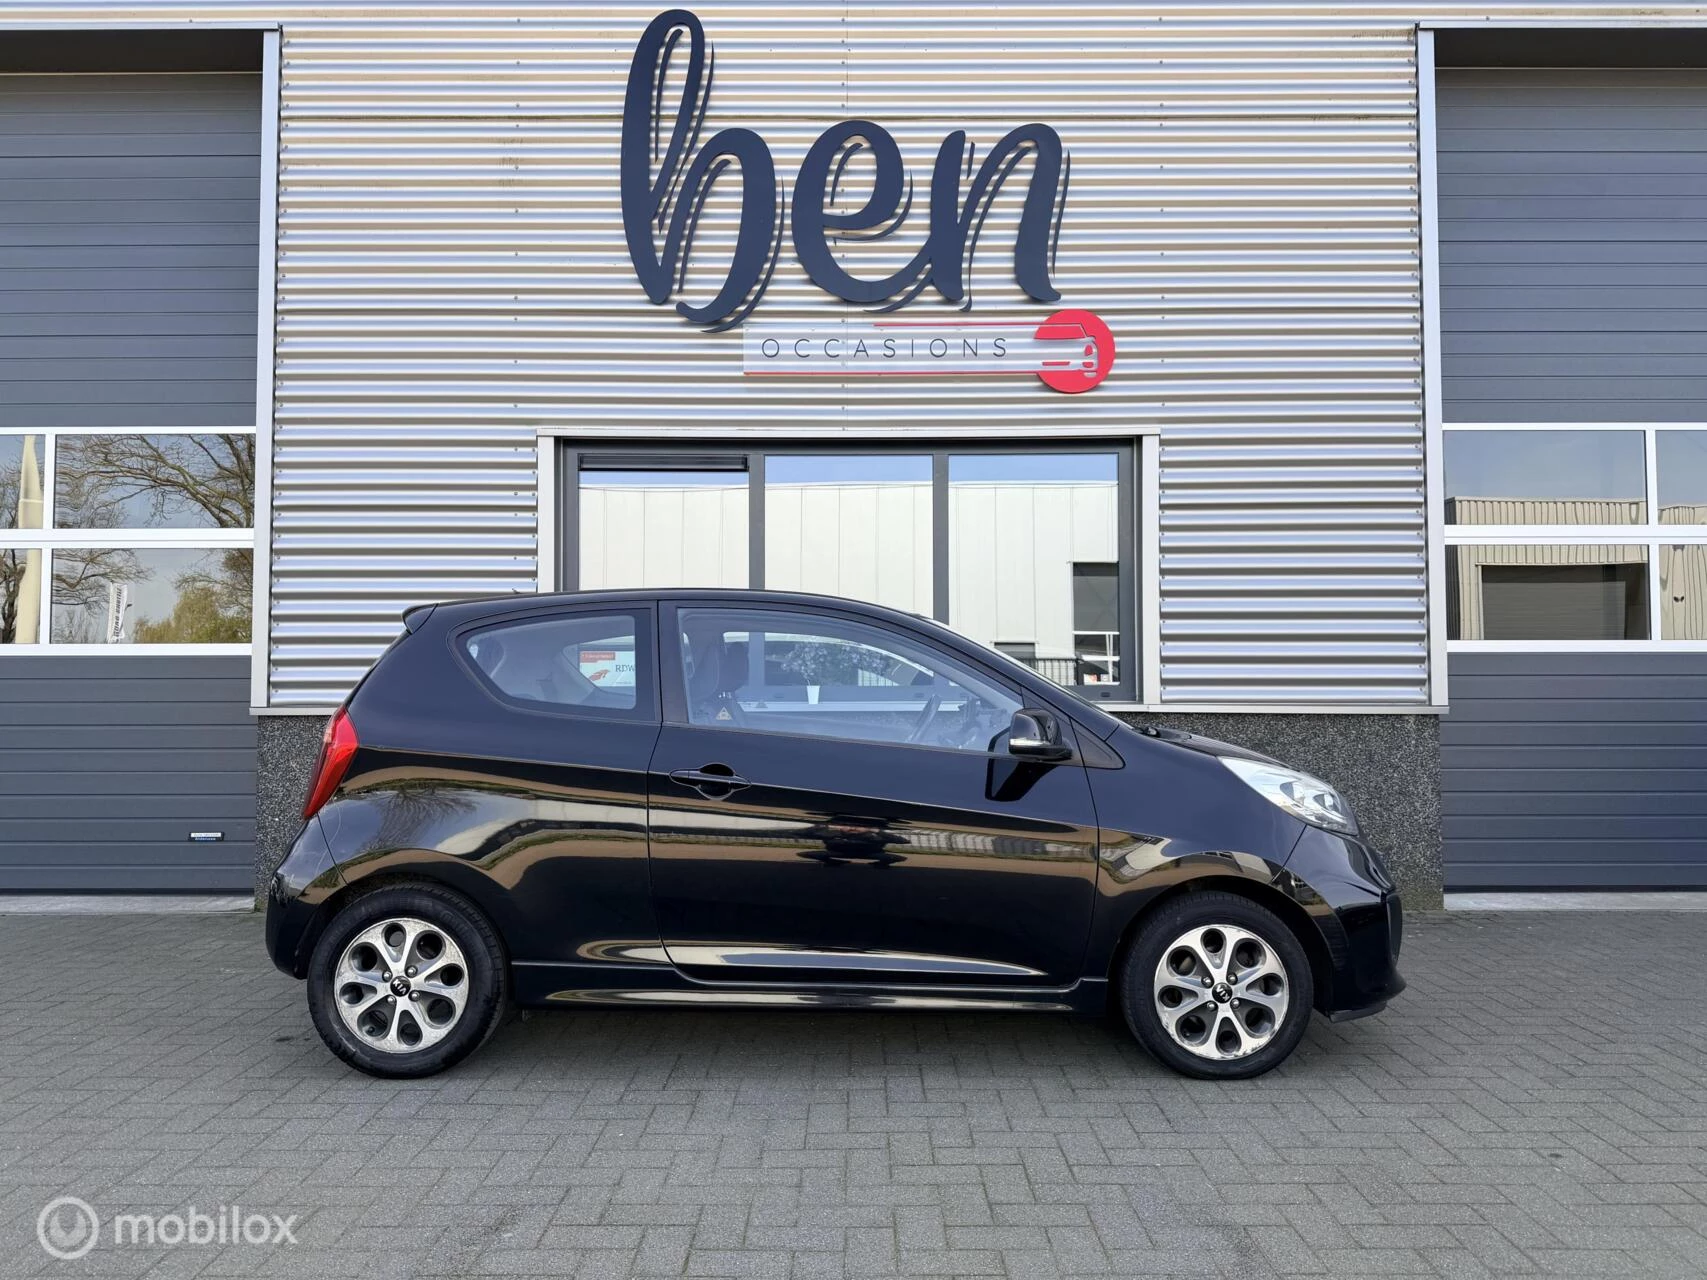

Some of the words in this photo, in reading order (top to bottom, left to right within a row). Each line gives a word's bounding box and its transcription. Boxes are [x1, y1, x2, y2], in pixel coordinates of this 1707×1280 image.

[620, 9, 1071, 333] ben
[761, 338, 1007, 359] OCCASIONS
[392, 978, 407, 995] KIA
[1216, 984, 1231, 1002] KIA
